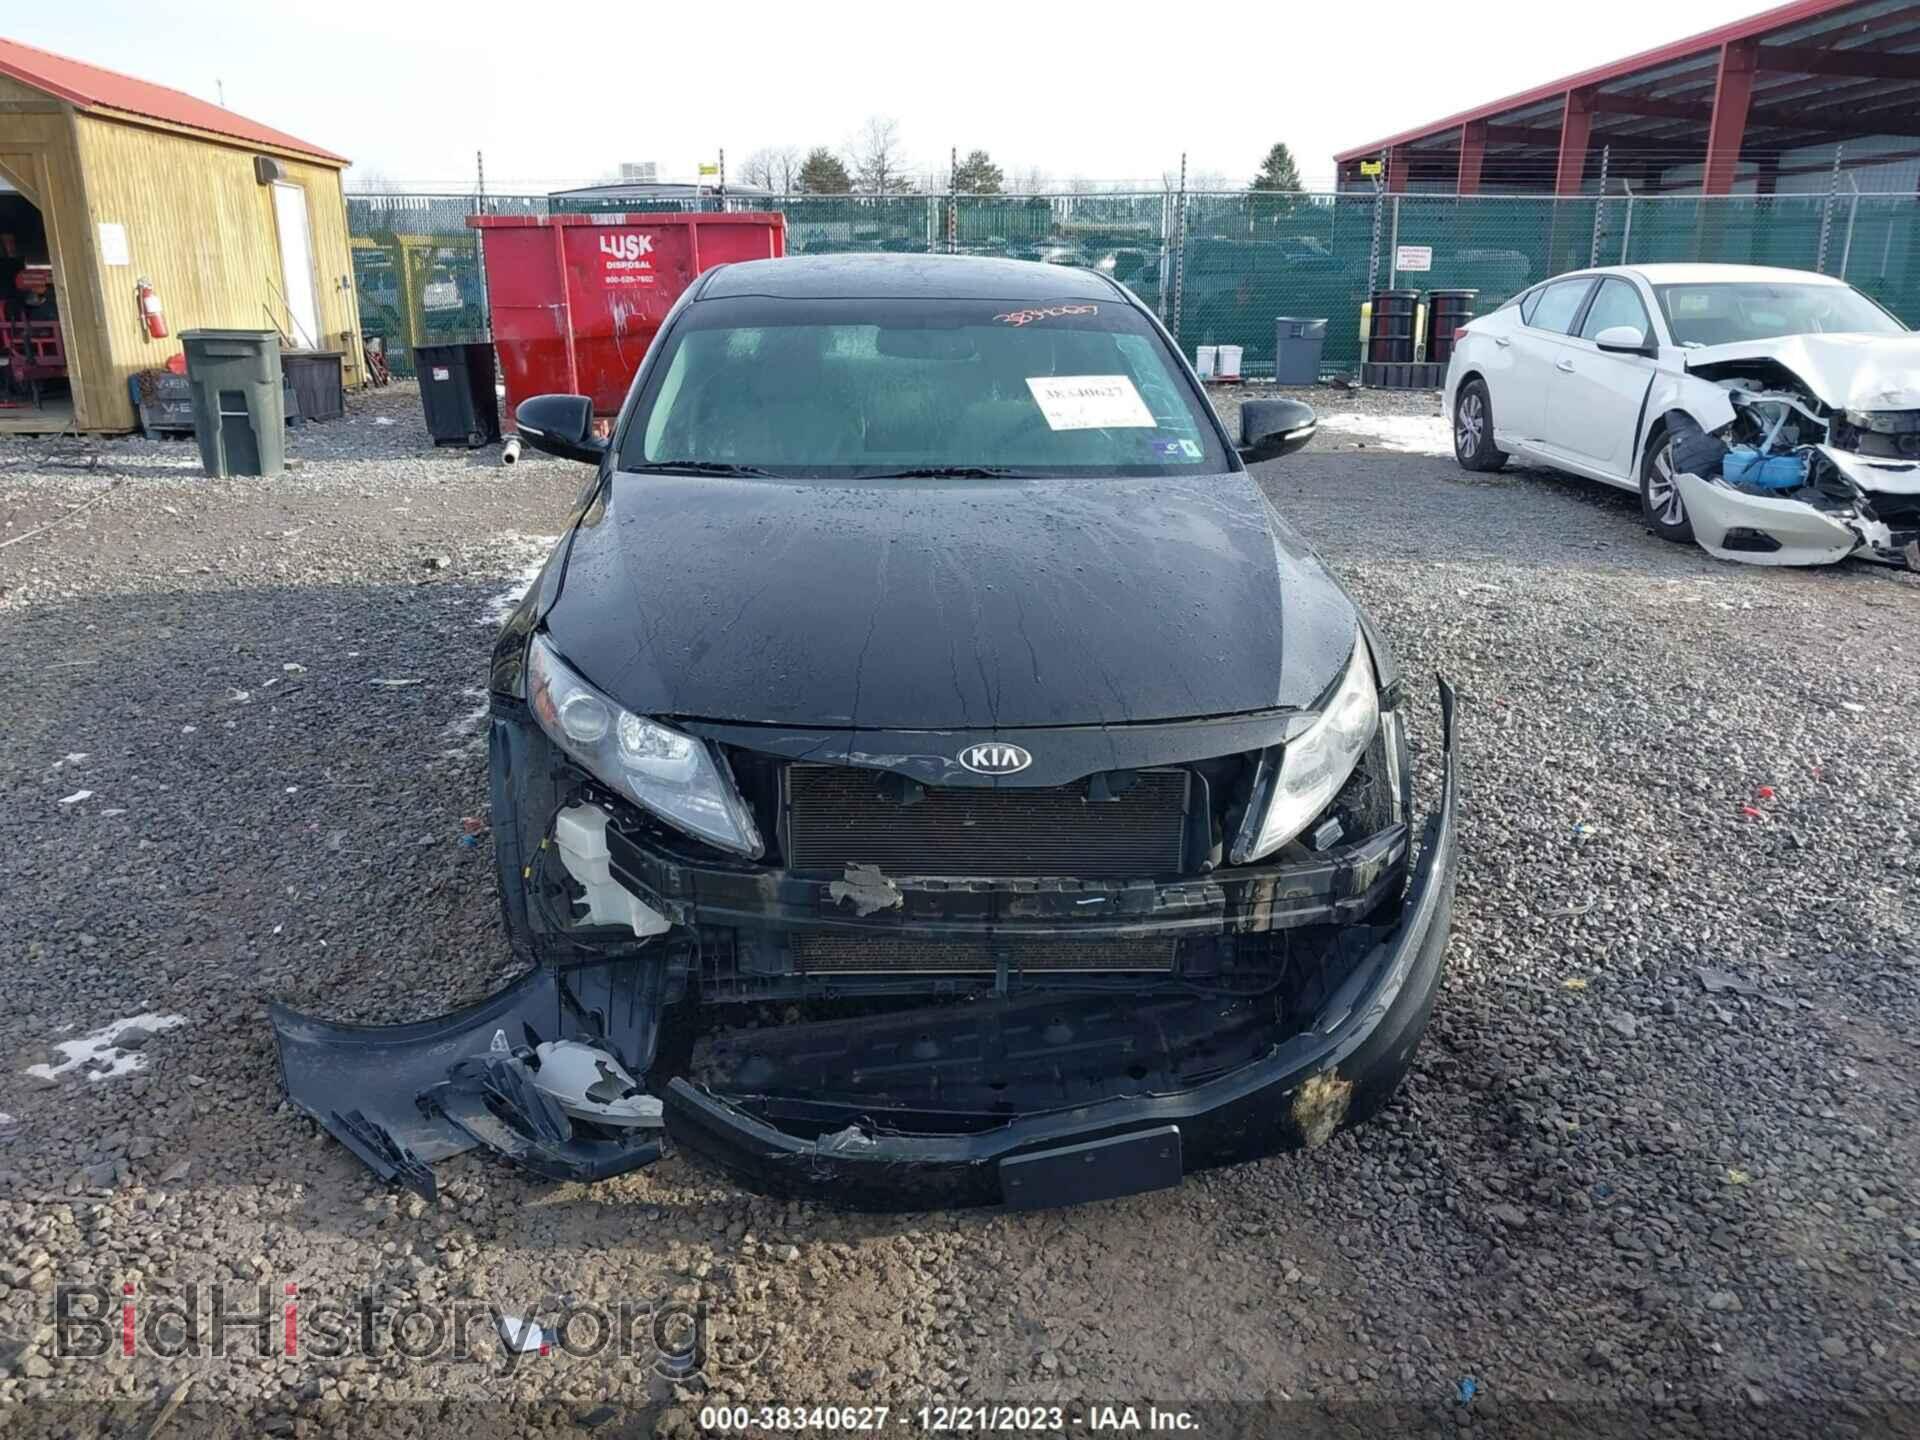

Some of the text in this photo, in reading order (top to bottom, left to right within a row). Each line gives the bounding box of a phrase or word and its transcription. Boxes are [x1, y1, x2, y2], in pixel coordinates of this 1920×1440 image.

[599, 234, 653, 260] LUSK
[606, 261, 651, 269] DISPOSAL
[971, 747, 1020, 767] KIA
